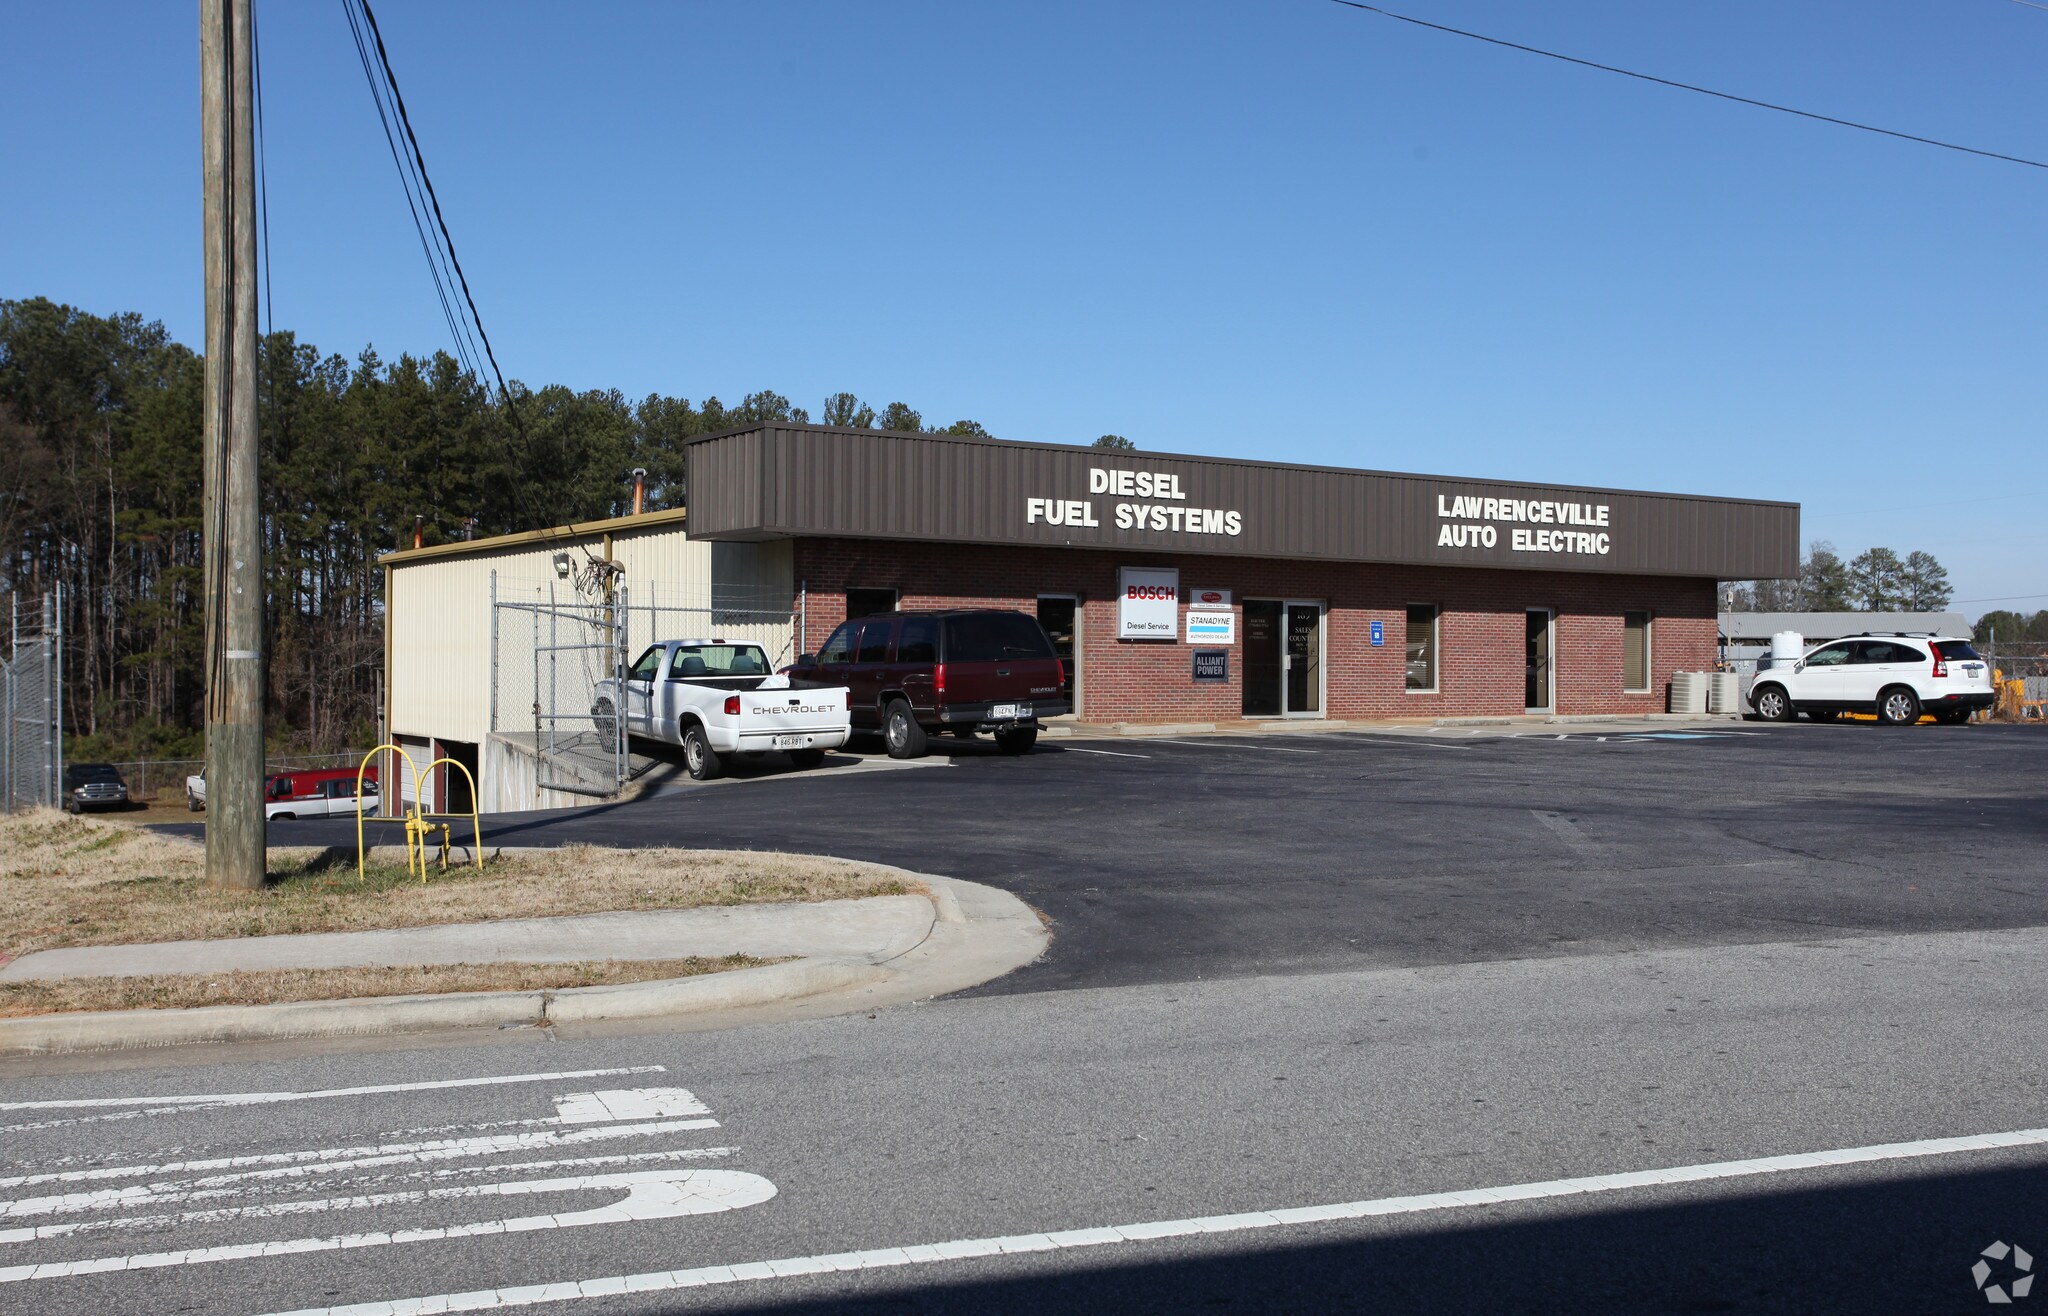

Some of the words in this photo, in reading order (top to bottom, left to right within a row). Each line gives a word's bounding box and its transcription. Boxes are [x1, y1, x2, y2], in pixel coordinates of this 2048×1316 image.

[1090, 468, 1186, 500] DIESEL
[1438, 494, 1609, 527] LAWRENCEVILLE
[1027, 498, 1098, 527] FUEL
[1115, 503, 1242, 536] SYSTEMS
[1437, 524, 1497, 548] AUTO
[1512, 529, 1610, 555] ELECTRIC
[1127, 585, 1175, 601] BOSCH
[1127, 621, 1147, 630] Diesel
[1148, 622, 1170, 630] Service
[1190, 616, 1231, 625] STANADYNE
[1295, 626, 1312, 634] SALES
[1196, 656, 1225, 666] ALLIANT
[1197, 666, 1223, 675] POWER
[752, 705, 836, 715] CHEVROLET
